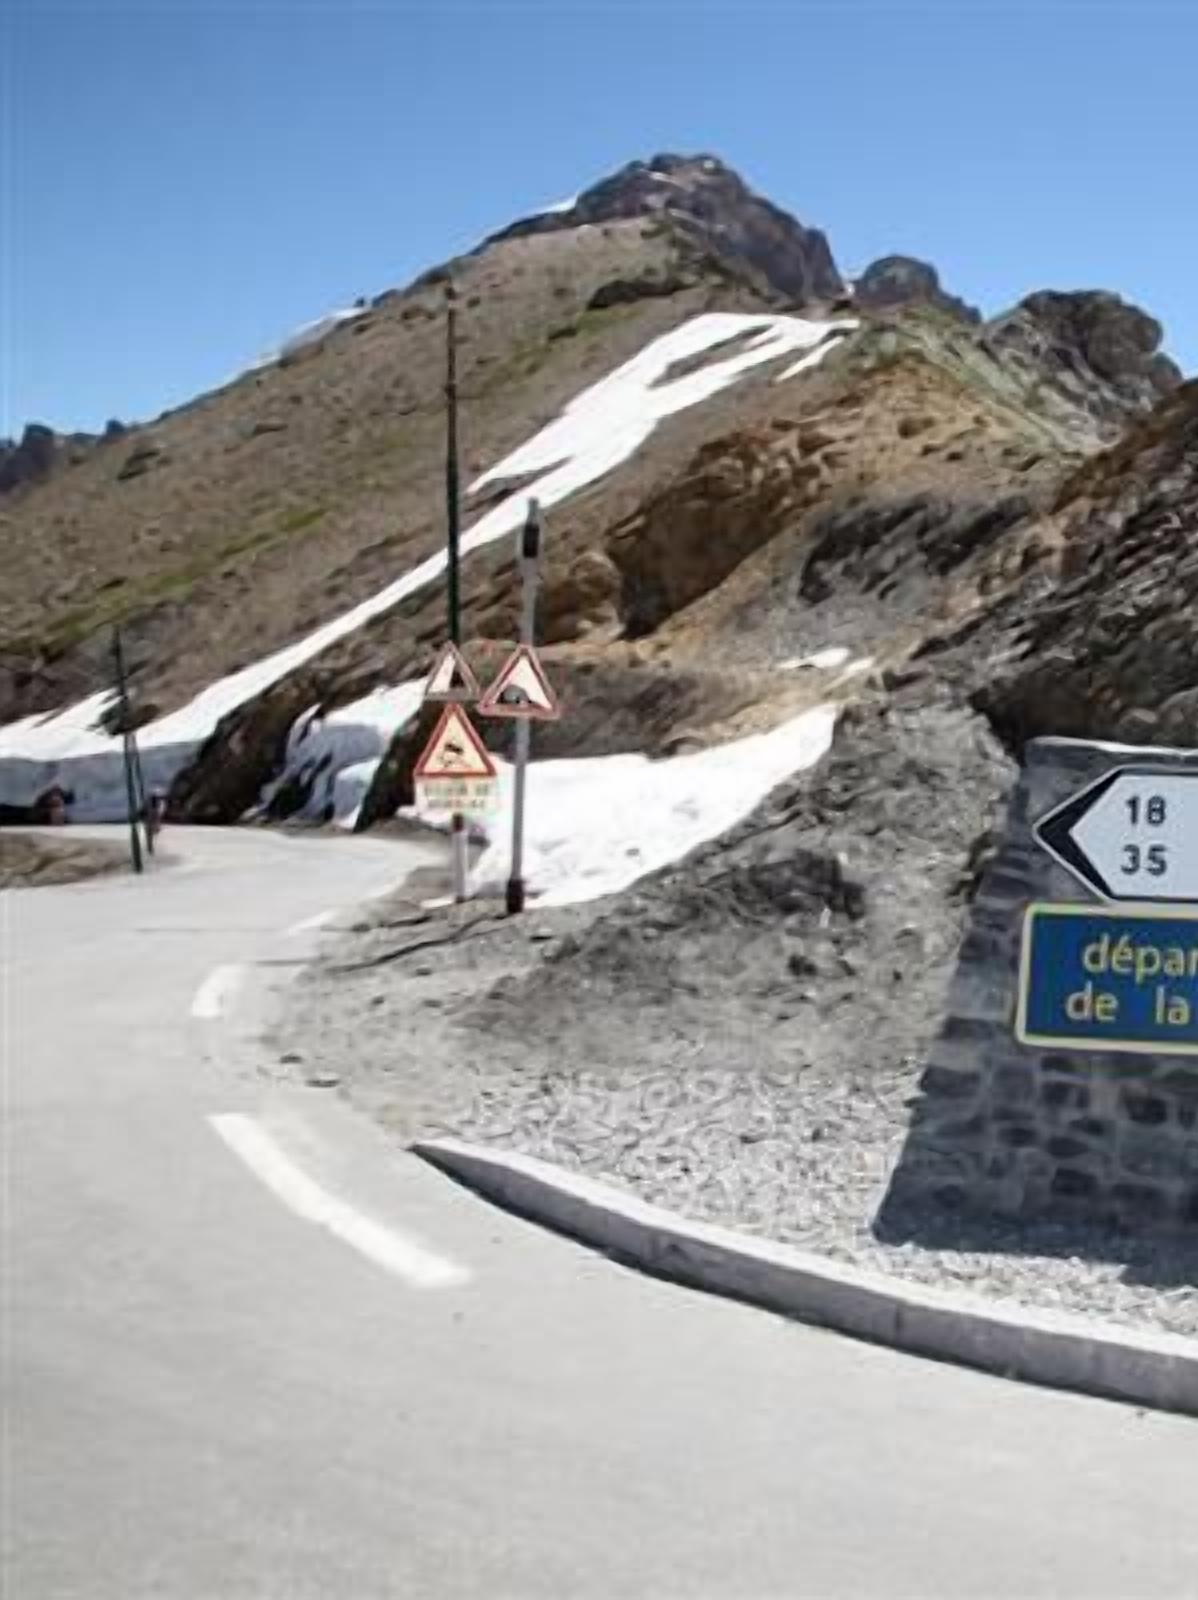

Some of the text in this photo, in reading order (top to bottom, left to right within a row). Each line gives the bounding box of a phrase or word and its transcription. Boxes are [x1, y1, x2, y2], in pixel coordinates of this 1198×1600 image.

[1124, 796, 1167, 826] 18
[1120, 845, 1167, 875] 35
[1066, 982, 1119, 1022] de
[1157, 988, 1190, 1026] la
